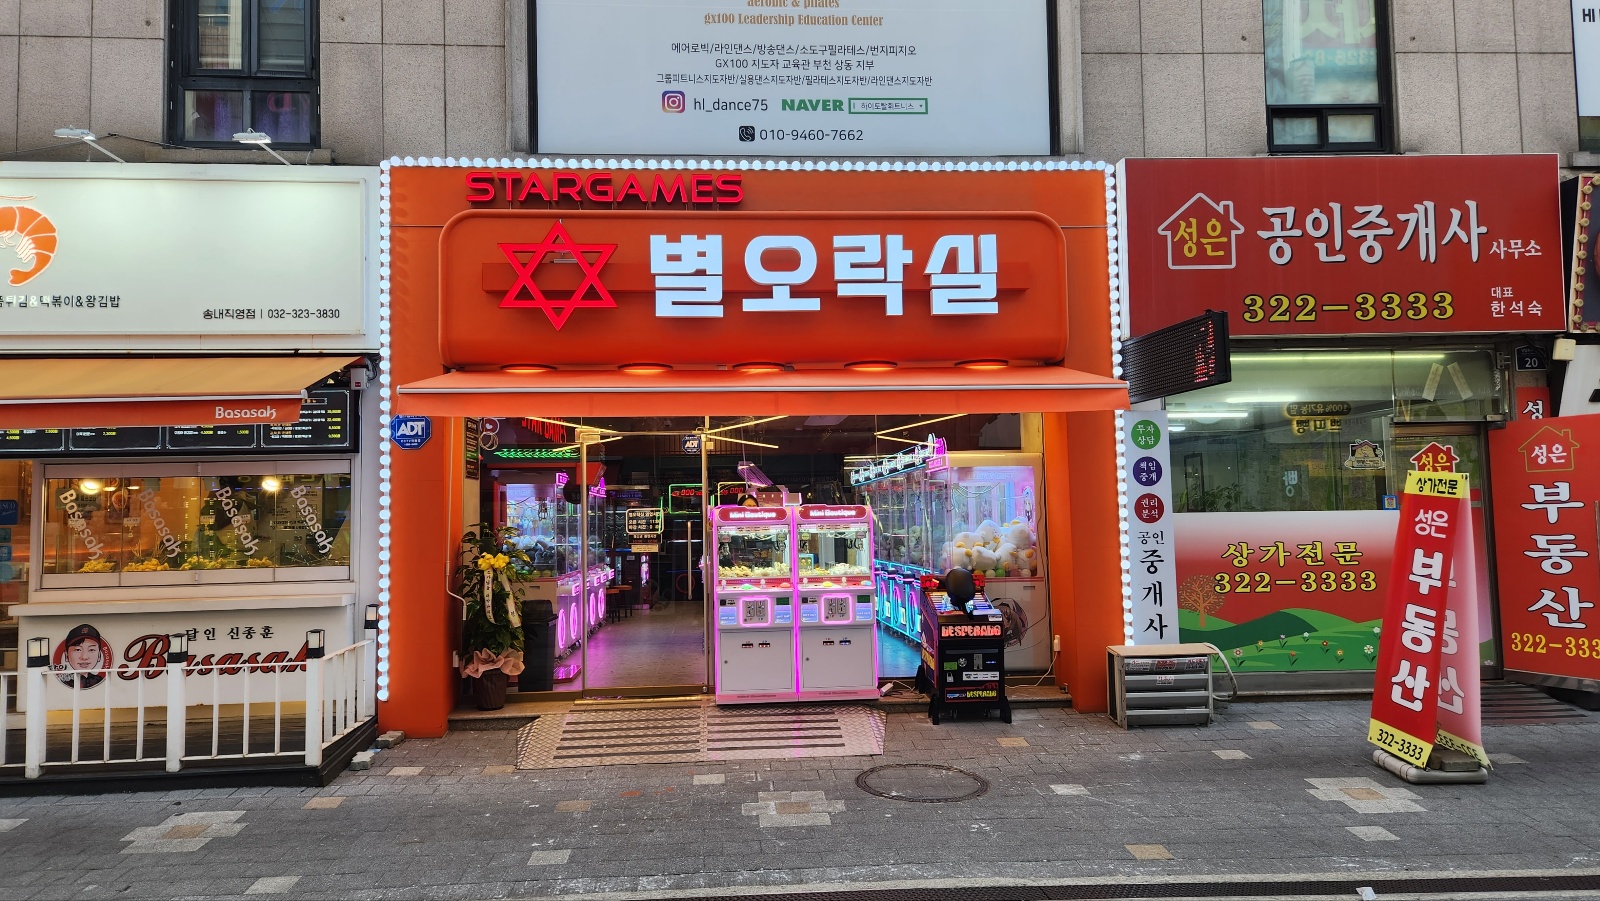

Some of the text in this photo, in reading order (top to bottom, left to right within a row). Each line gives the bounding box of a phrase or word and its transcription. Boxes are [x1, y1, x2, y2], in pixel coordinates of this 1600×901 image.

[704, 13, 884, 27] gx100 Leadership Education Center
[1582, 8, 1596, 22] HI
[715, 58, 875, 71] GX100 지도자 교육관 부천 상동 지부
[693, 98, 769, 113] hl_dance75
[782, 99, 845, 112] NAVER
[759, 129, 864, 141] 010-9460-7662
[465, 171, 744, 203] STARGAMES
[1173, 217, 1228, 258] 성은
[1256, 199, 1543, 266] 공인중개사 사무소
[649, 233, 998, 318] 별오락실
[1490, 287, 1514, 298] 대표
[203, 308, 340, 320] 송내직영점 032-323-3830
[1241, 291, 1455, 323] 322-3333
[1490, 300, 1543, 317] 한석숙
[1524, 357, 1539, 368] 20
[214, 405, 277, 420] Basasak
[397, 421, 425, 436] ADT
[684, 440, 699, 448] ADT
[1137, 435, 1155, 445] 상담
[1531, 443, 1567, 465] 성은
[1139, 461, 1156, 471] 책임
[1419, 452, 1451, 473] 성은
[1139, 471, 1157, 482] 중개
[1416, 477, 1459, 495] 상가전문
[1141, 498, 1158, 508] 권리
[290, 485, 334, 554] Basasak
[729, 511, 777, 519] Mini Boutique
[810, 508, 856, 517] Mini Boutique
[1142, 508, 1159, 519] 분석
[59, 489, 104, 560] Basasak
[137, 487, 183, 559] Basasak
[215, 486, 259, 556] Basasak
[1414, 508, 1449, 539] 성은
[1137, 530, 1165, 545] 공인
[1220, 540, 1363, 568] 상가전문
[1520, 481, 1595, 629] 부동산
[1214, 570, 1377, 594] 322-3333
[1139, 549, 1168, 640] 중개사
[226, 625, 275, 640] 신종훈
[1391, 548, 1444, 712] 부동산
[1376, 728, 1424, 761] 322-3333
